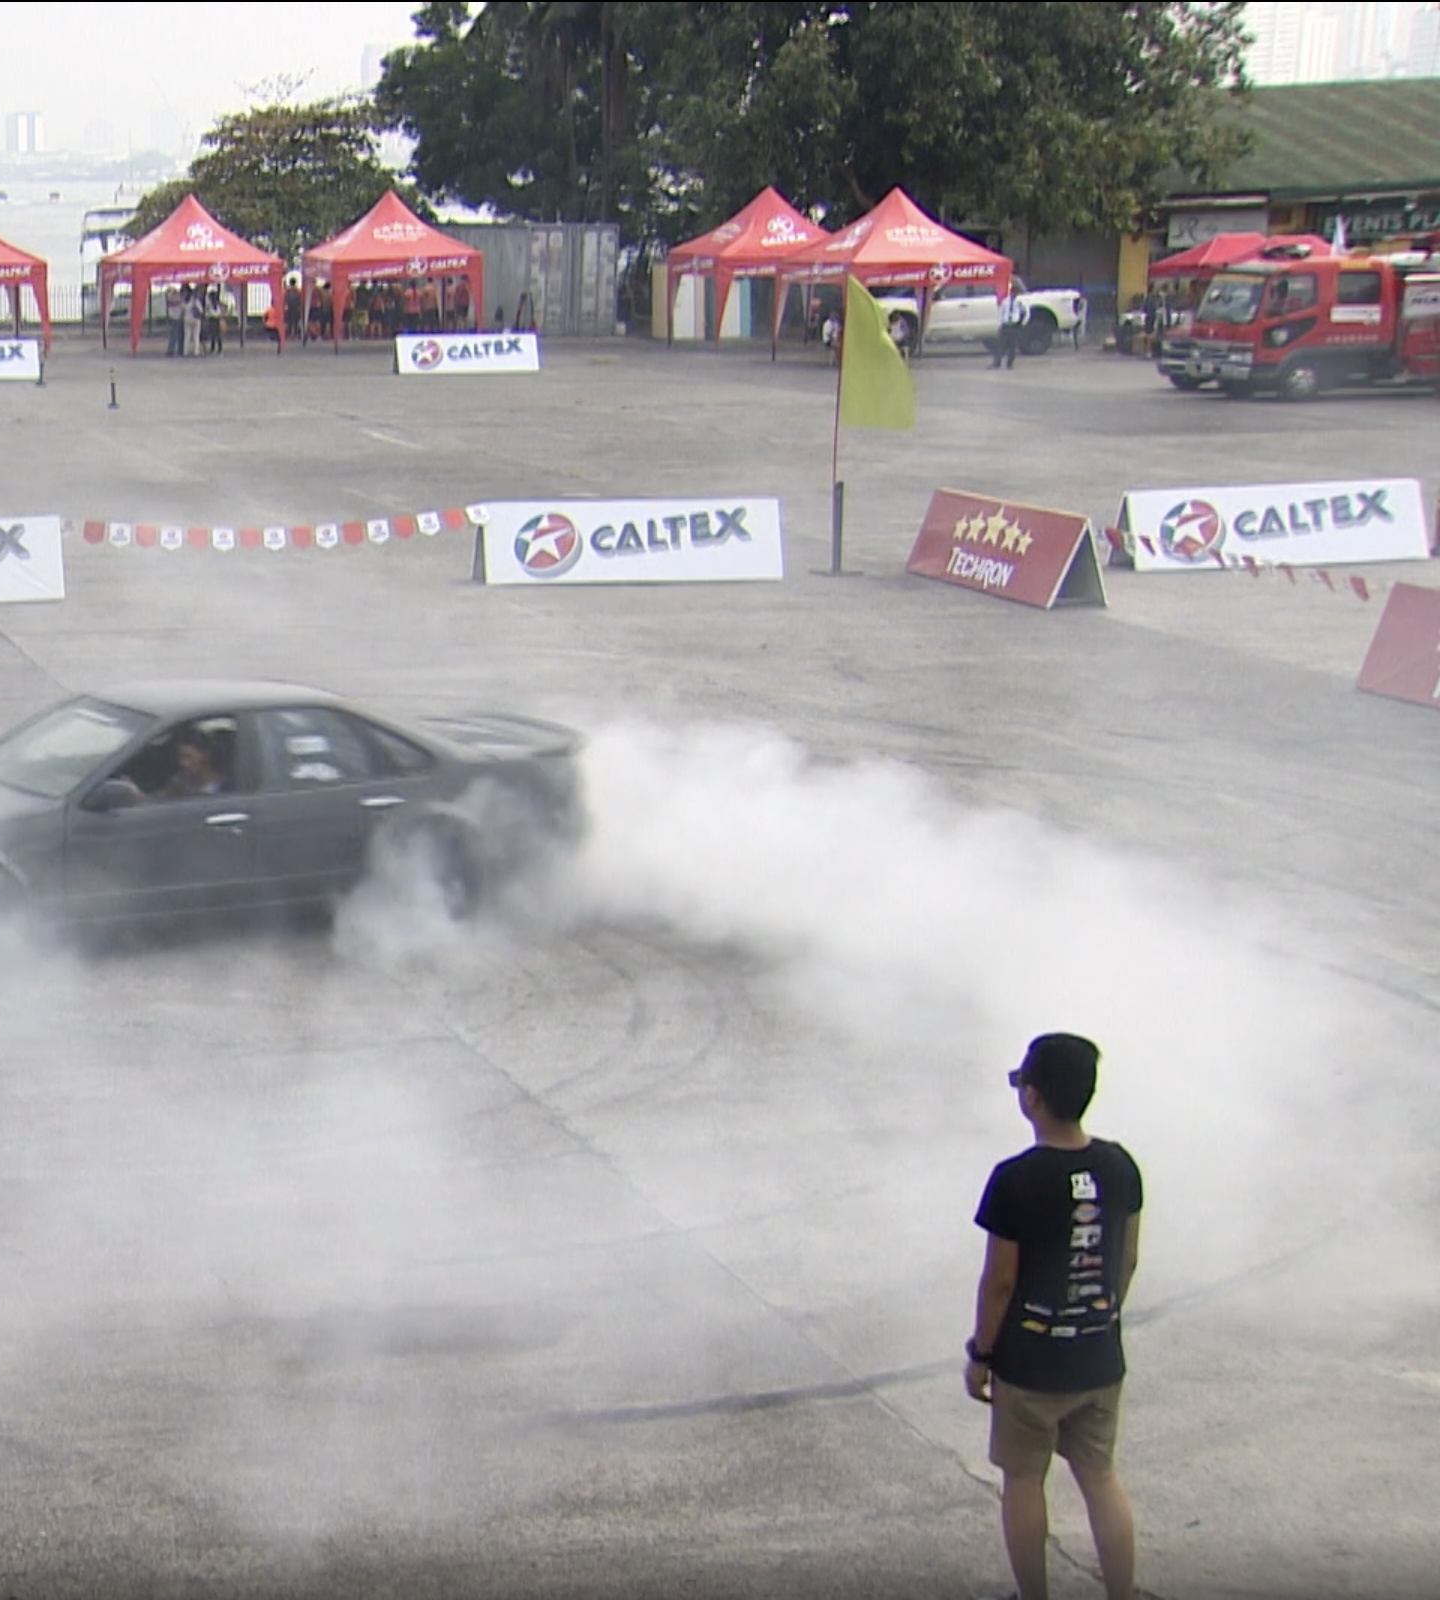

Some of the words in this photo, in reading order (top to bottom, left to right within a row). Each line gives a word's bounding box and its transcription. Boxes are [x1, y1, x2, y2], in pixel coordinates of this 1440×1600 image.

[446, 338, 523, 362] CALTEX
[589, 506, 752, 557] CALTEX
[1232, 488, 1394, 542] CALTEX
[945, 545, 1013, 589] TECHRON
